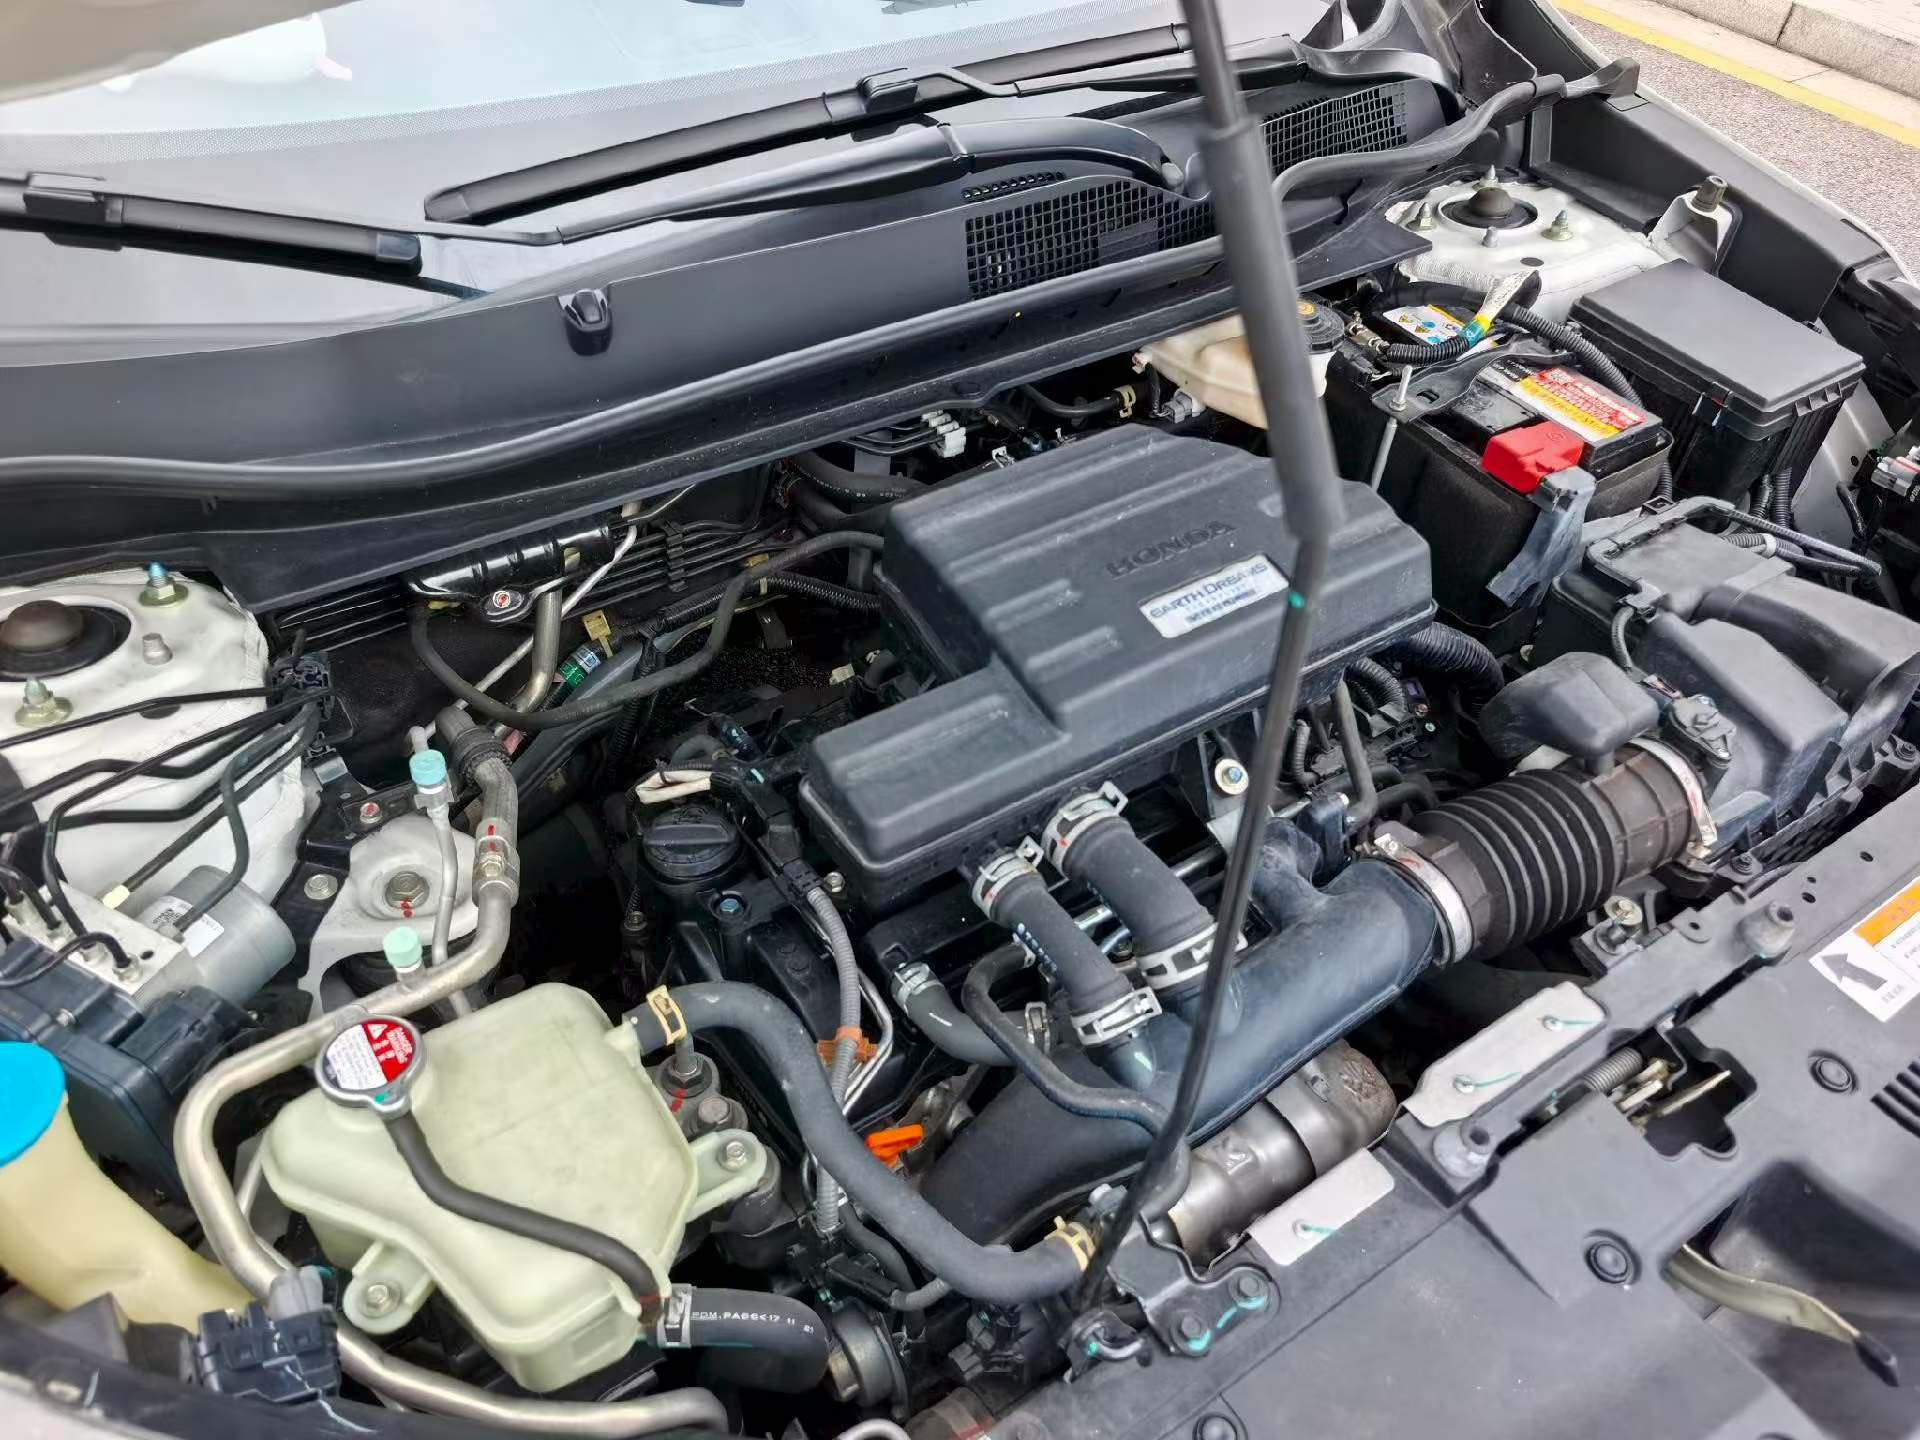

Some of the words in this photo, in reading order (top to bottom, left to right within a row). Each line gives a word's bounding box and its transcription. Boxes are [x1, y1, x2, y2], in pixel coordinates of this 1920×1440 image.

[1106, 521, 1237, 578] HONDA
[1150, 590, 1204, 618] EARTH
[1203, 562, 1268, 594] DREAMS
